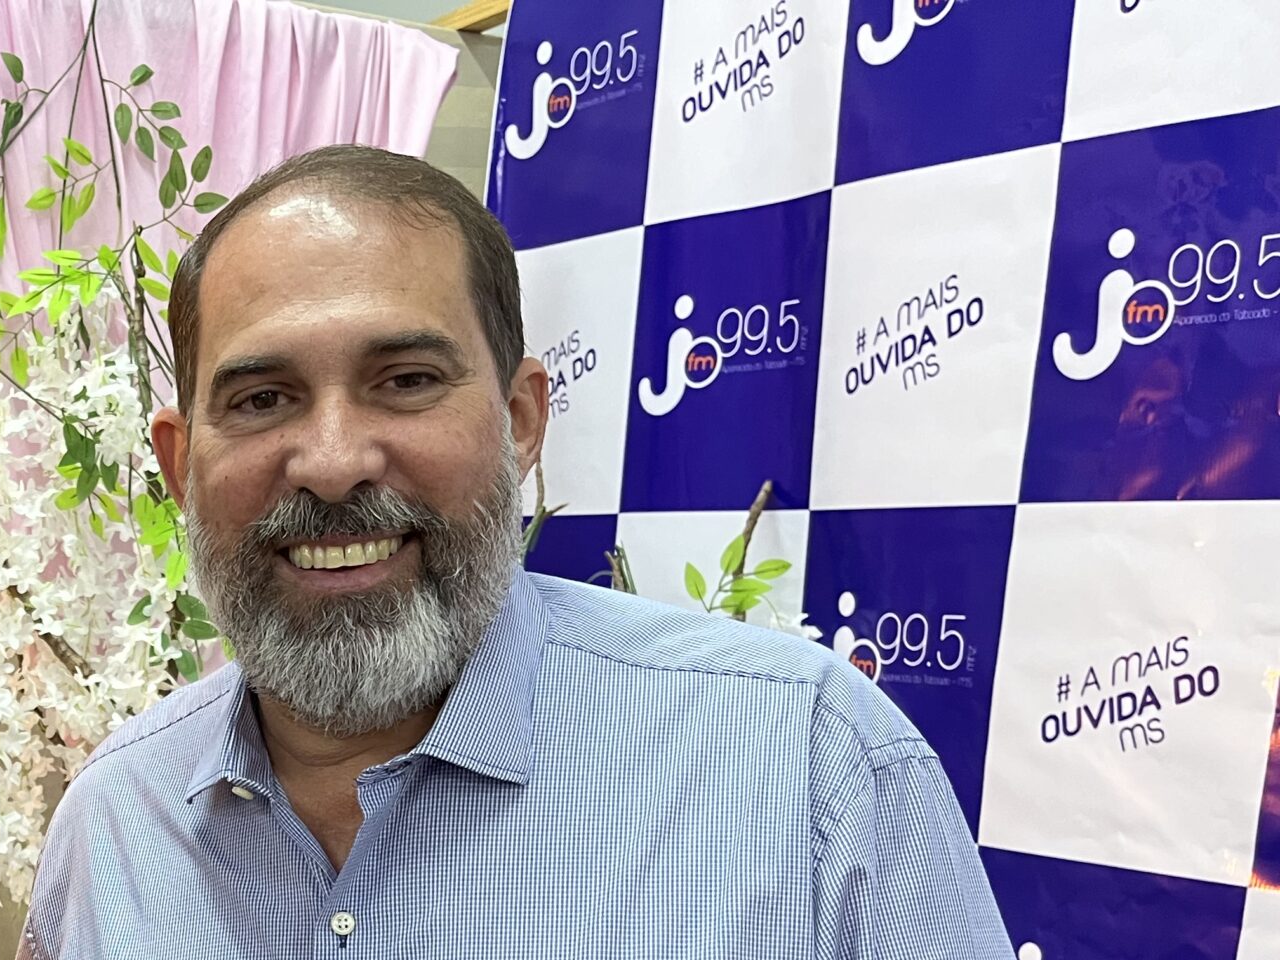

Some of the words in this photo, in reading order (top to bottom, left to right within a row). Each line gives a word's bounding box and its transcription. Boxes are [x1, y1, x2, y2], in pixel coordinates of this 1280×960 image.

[549, 94, 570, 113] fm
[570, 30, 639, 96] 99.5
[681, 49, 771, 123] OUVIDA
[778, 17, 805, 58] DO
[693, 59, 705, 84] #
[712, 47, 729, 74] A
[1127, 300, 1165, 324] fm
[1168, 233, 1280, 306] 99.5
[573, 348, 596, 380] DO
[687, 352, 715, 372] fm
[717, 299, 800, 358] 99.5
[845, 325, 937, 395] OUVIDA
[946, 297, 984, 338] DO
[856, 327, 867, 354] #
[873, 317, 889, 347] A
[876, 612, 966, 671] 99.5
[1040, 685, 1161, 744] OUVIDA
[1173, 665, 1220, 706] DO
[1056, 674, 1072, 703] #
[1080, 665, 1102, 697] A
